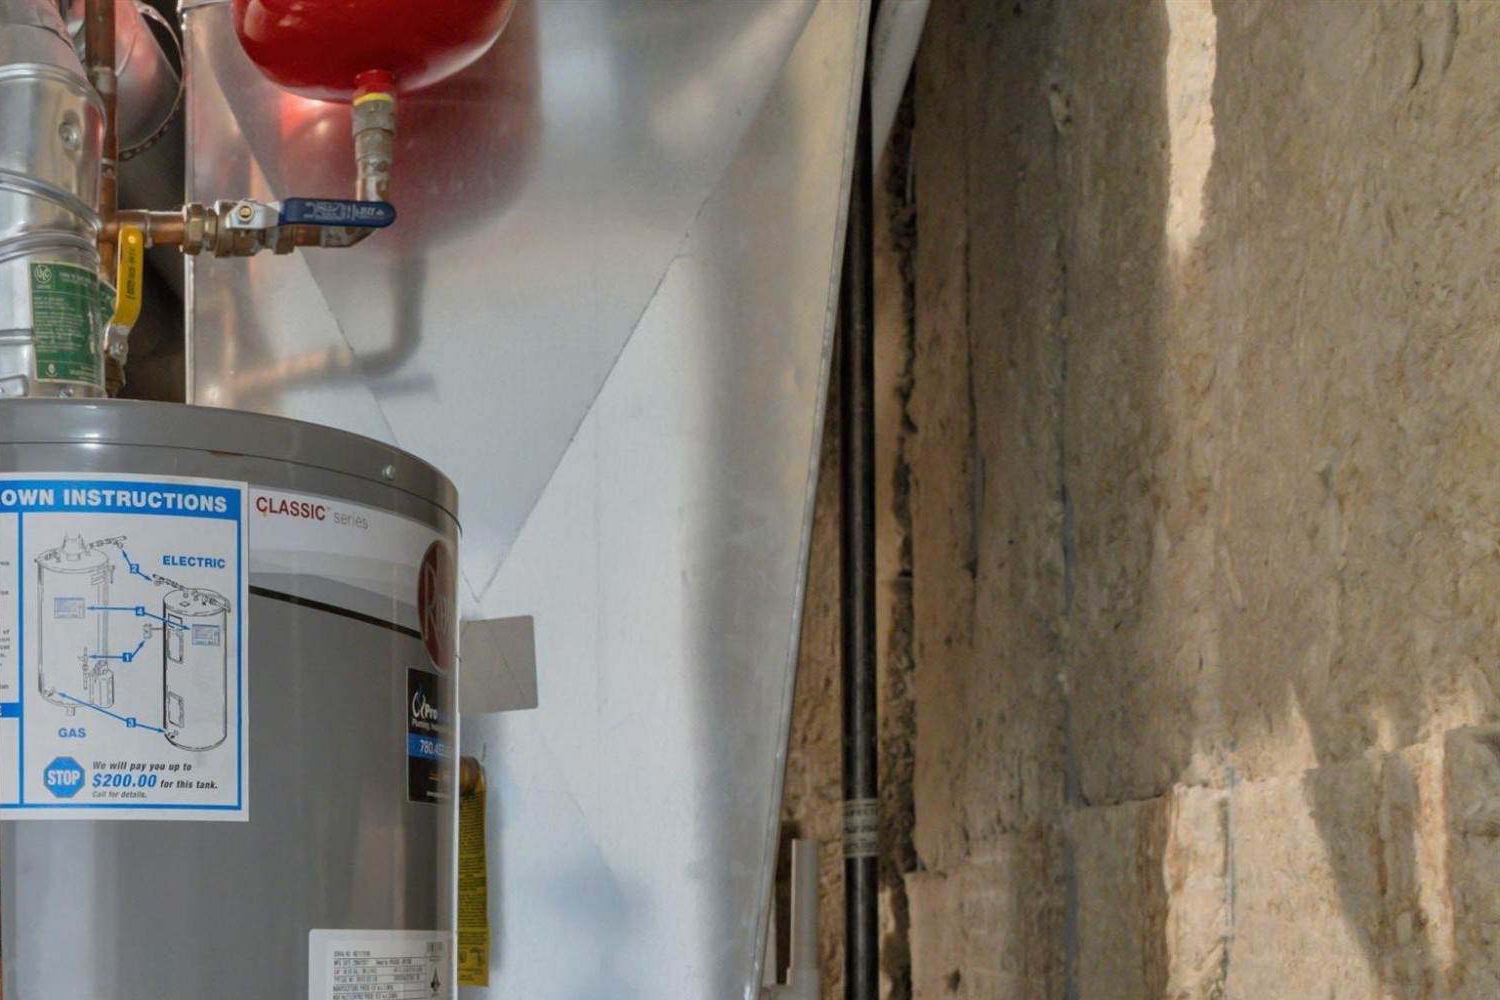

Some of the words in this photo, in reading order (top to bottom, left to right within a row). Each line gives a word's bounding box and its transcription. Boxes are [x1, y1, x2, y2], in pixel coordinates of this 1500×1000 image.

[63, 489, 228, 513] INSTRUCTIONS
[256, 496, 326, 521] CLASSIC
[162, 555, 226, 569] ELECTRIC
[58, 727, 86, 738] GAS
[92, 761, 106, 770] We
[109, 761, 127, 771] will
[130, 763, 146, 773] pay
[149, 763, 166, 773] you
[168, 763, 180, 773] up
[182, 763, 192, 771] to
[47, 769, 81, 786] STOP
[92, 773, 157, 788] $200.00
[160, 779, 173, 788] for
[176, 780, 193, 789] this
[196, 780, 218, 790] tank.
[92, 790, 106, 798] Call
[108, 790, 119, 798] for
[120, 791, 147, 799] details.
